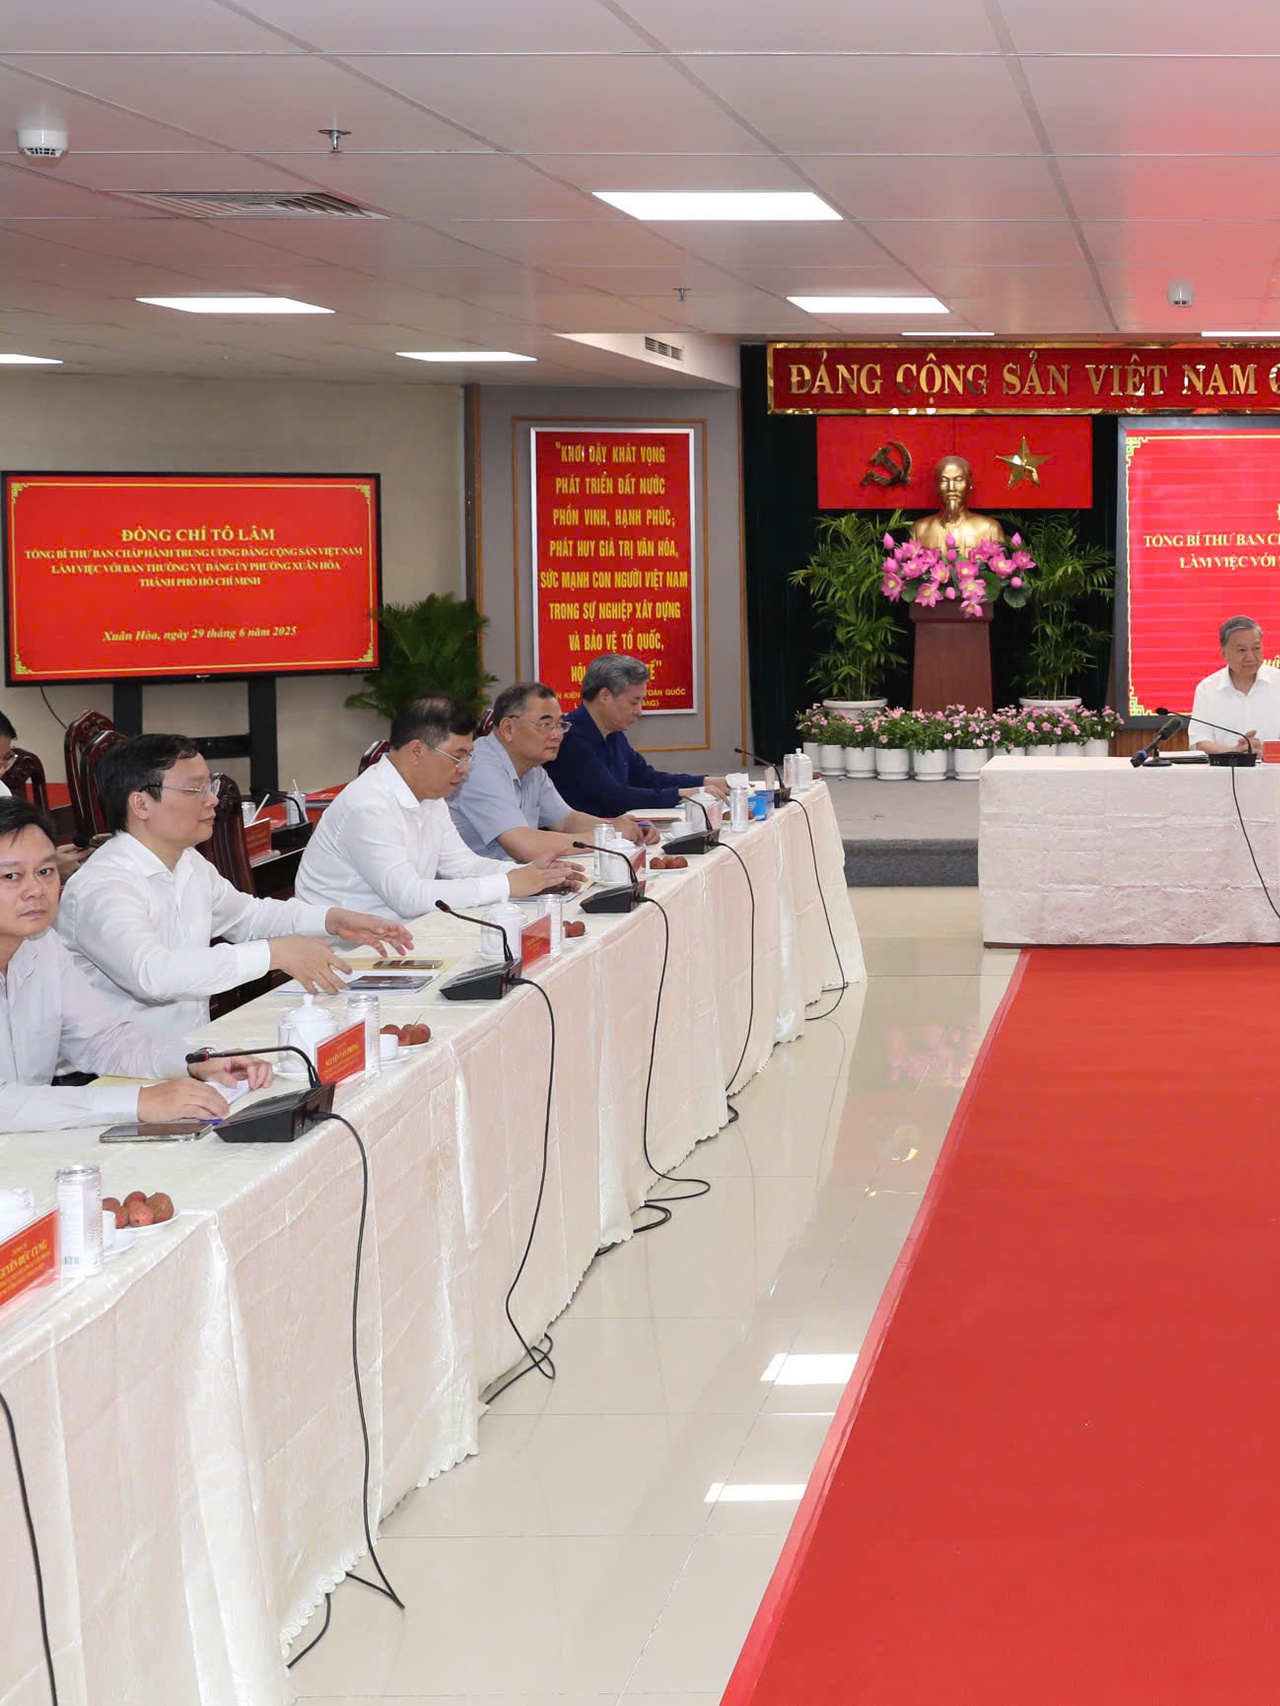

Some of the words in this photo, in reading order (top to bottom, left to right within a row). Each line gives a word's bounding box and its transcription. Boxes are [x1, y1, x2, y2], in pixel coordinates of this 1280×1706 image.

[789, 350, 883, 394] ĐẢNG
[896, 353, 988, 404] CỘNG
[1002, 351, 1070, 394] SẢN
[1085, 354, 1168, 404] VIỆT
[1182, 363, 1258, 394] NAM
[612, 443, 636, 462] KHÁT
[640, 446, 665, 466] VỌNG
[556, 474, 580, 494] PHÁT
[585, 471, 613, 494] TRIỂN
[618, 474, 635, 494] ĐẤT
[640, 474, 665, 494] NƯỚC
[584, 508, 610, 527] VINH,
[615, 508, 642, 528] HẠNH
[121, 526, 172, 541] ĐỒNG
[176, 526, 206, 541] CHÍ
[210, 526, 234, 541] TÔ
[238, 526, 275, 541] LÂM
[1143, 533, 1183, 547] TỔNG
[1187, 531, 1201, 546] BÍ
[1203, 532, 1236, 546] THƯ
[1236, 533, 1265, 545] BAN
[550, 537, 573, 557] PHÁT
[599, 537, 615, 557] GIÁ
[618, 540, 634, 559] TRỊ
[636, 538, 654, 557] VĂN
[1179, 553, 1212, 568] LÀM
[1214, 554, 1248, 570] VIỆC
[1250, 552, 1276, 567] VỚI
[540, 568, 559, 588] SỨC
[561, 571, 589, 591] MẠNH
[592, 571, 611, 588] CON
[614, 568, 642, 588] NGƯỜI
[645, 568, 663, 591] VIỆT
[666, 571, 688, 588] NAM
[549, 602, 579, 619] TRONG
[583, 601, 596, 622] SỰ
[599, 599, 633, 621] NGHIỆP
[636, 599, 652, 618] XÂY
[656, 601, 681, 621] DỰNG
[103, 630, 132, 641] Xuân
[136, 630, 160, 642] Hòa,
[164, 629, 189, 641] ngày
[191, 629, 204, 639] 29
[206, 627, 236, 640] tháng
[239, 628, 245, 637] 6
[247, 628, 270, 637] năm
[273, 626, 297, 636] 2025
[569, 631, 580, 650] VÀ
[584, 629, 602, 650] BẢO
[606, 631, 617, 653] VỆ
[621, 627, 634, 650] TỔ
[637, 628, 665, 651] QUỐC,
